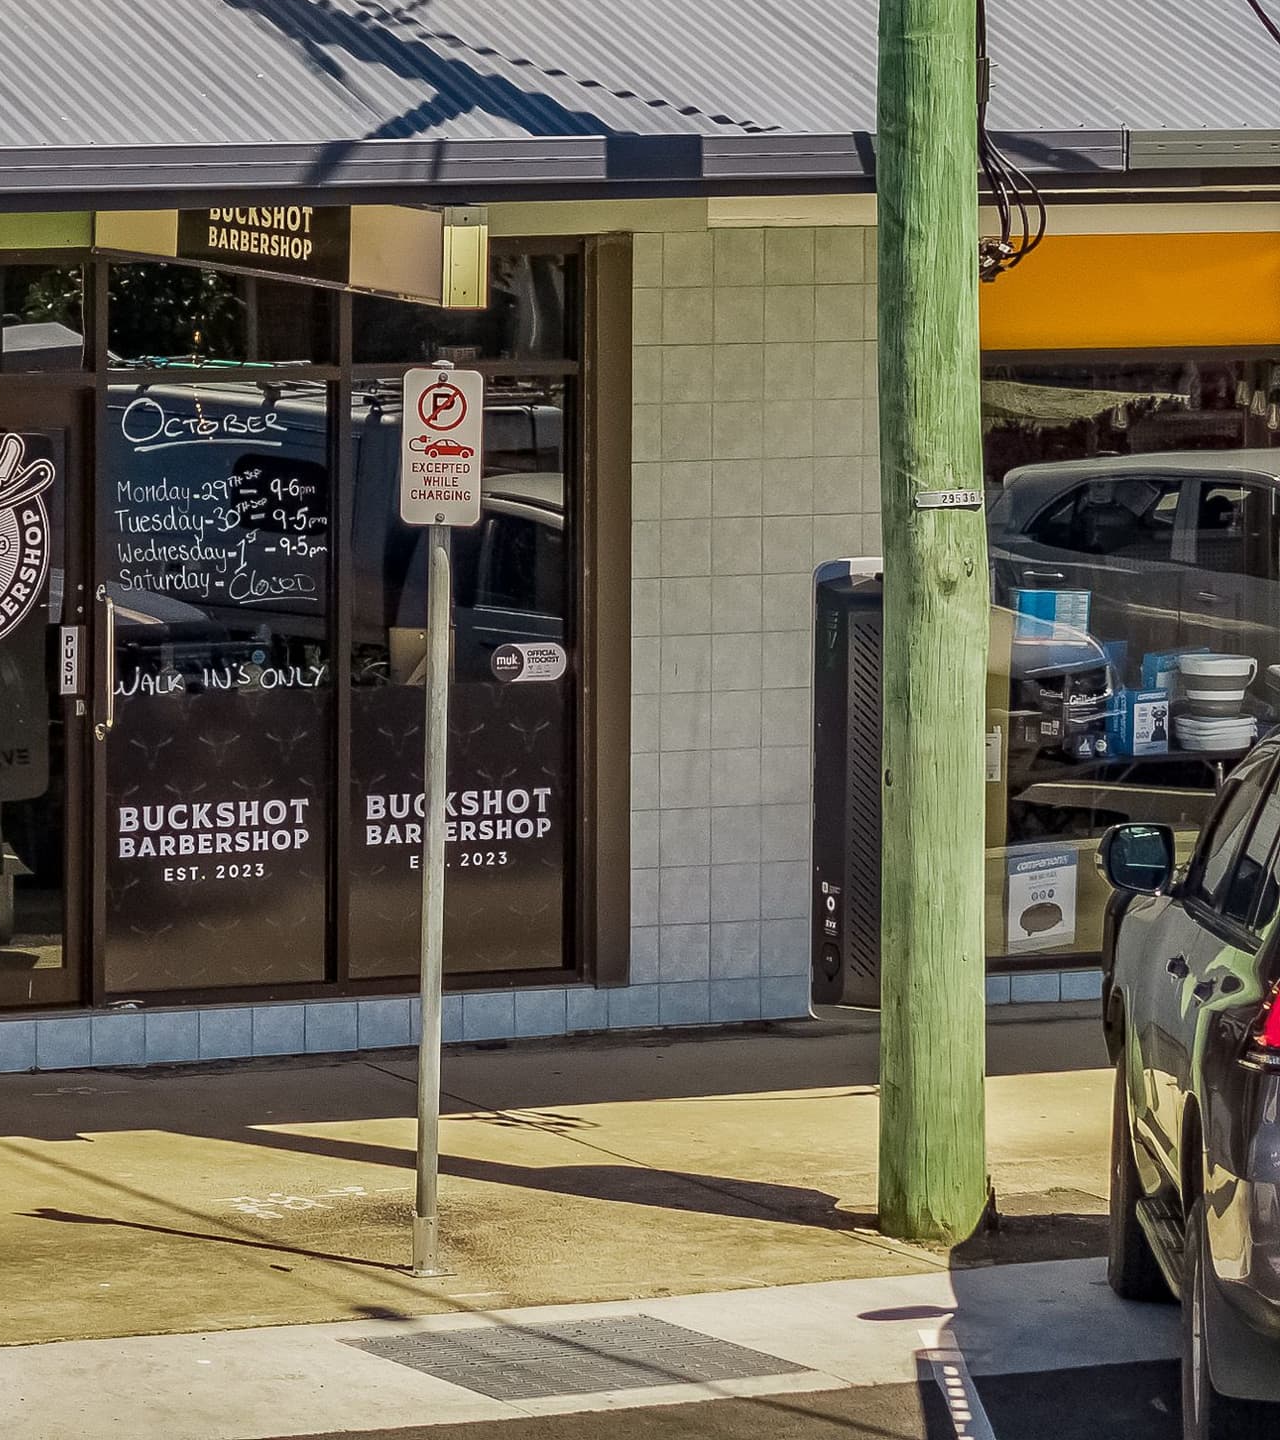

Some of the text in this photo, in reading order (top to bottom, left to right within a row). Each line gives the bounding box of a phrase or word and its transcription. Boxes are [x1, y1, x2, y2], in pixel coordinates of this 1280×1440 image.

[208, 226, 312, 260] BARBERSHOP
[412, 462, 470, 474] EXCEPTED
[423, 476, 458, 487] WHILE
[410, 489, 471, 501] CHARGING
[941, 493, 976, 503] 29536
[119, 566, 210, 598] Saturday
[64, 635, 74, 685] PUSH
[259, 664, 327, 689] ONLY
[119, 798, 309, 832] BUCKSHOT
[119, 829, 309, 858] BARBERSHOP
[366, 818, 551, 845] BARERSHOP
[164, 863, 265, 882] EST. 2023
[409, 851, 507, 869] E. 2023
